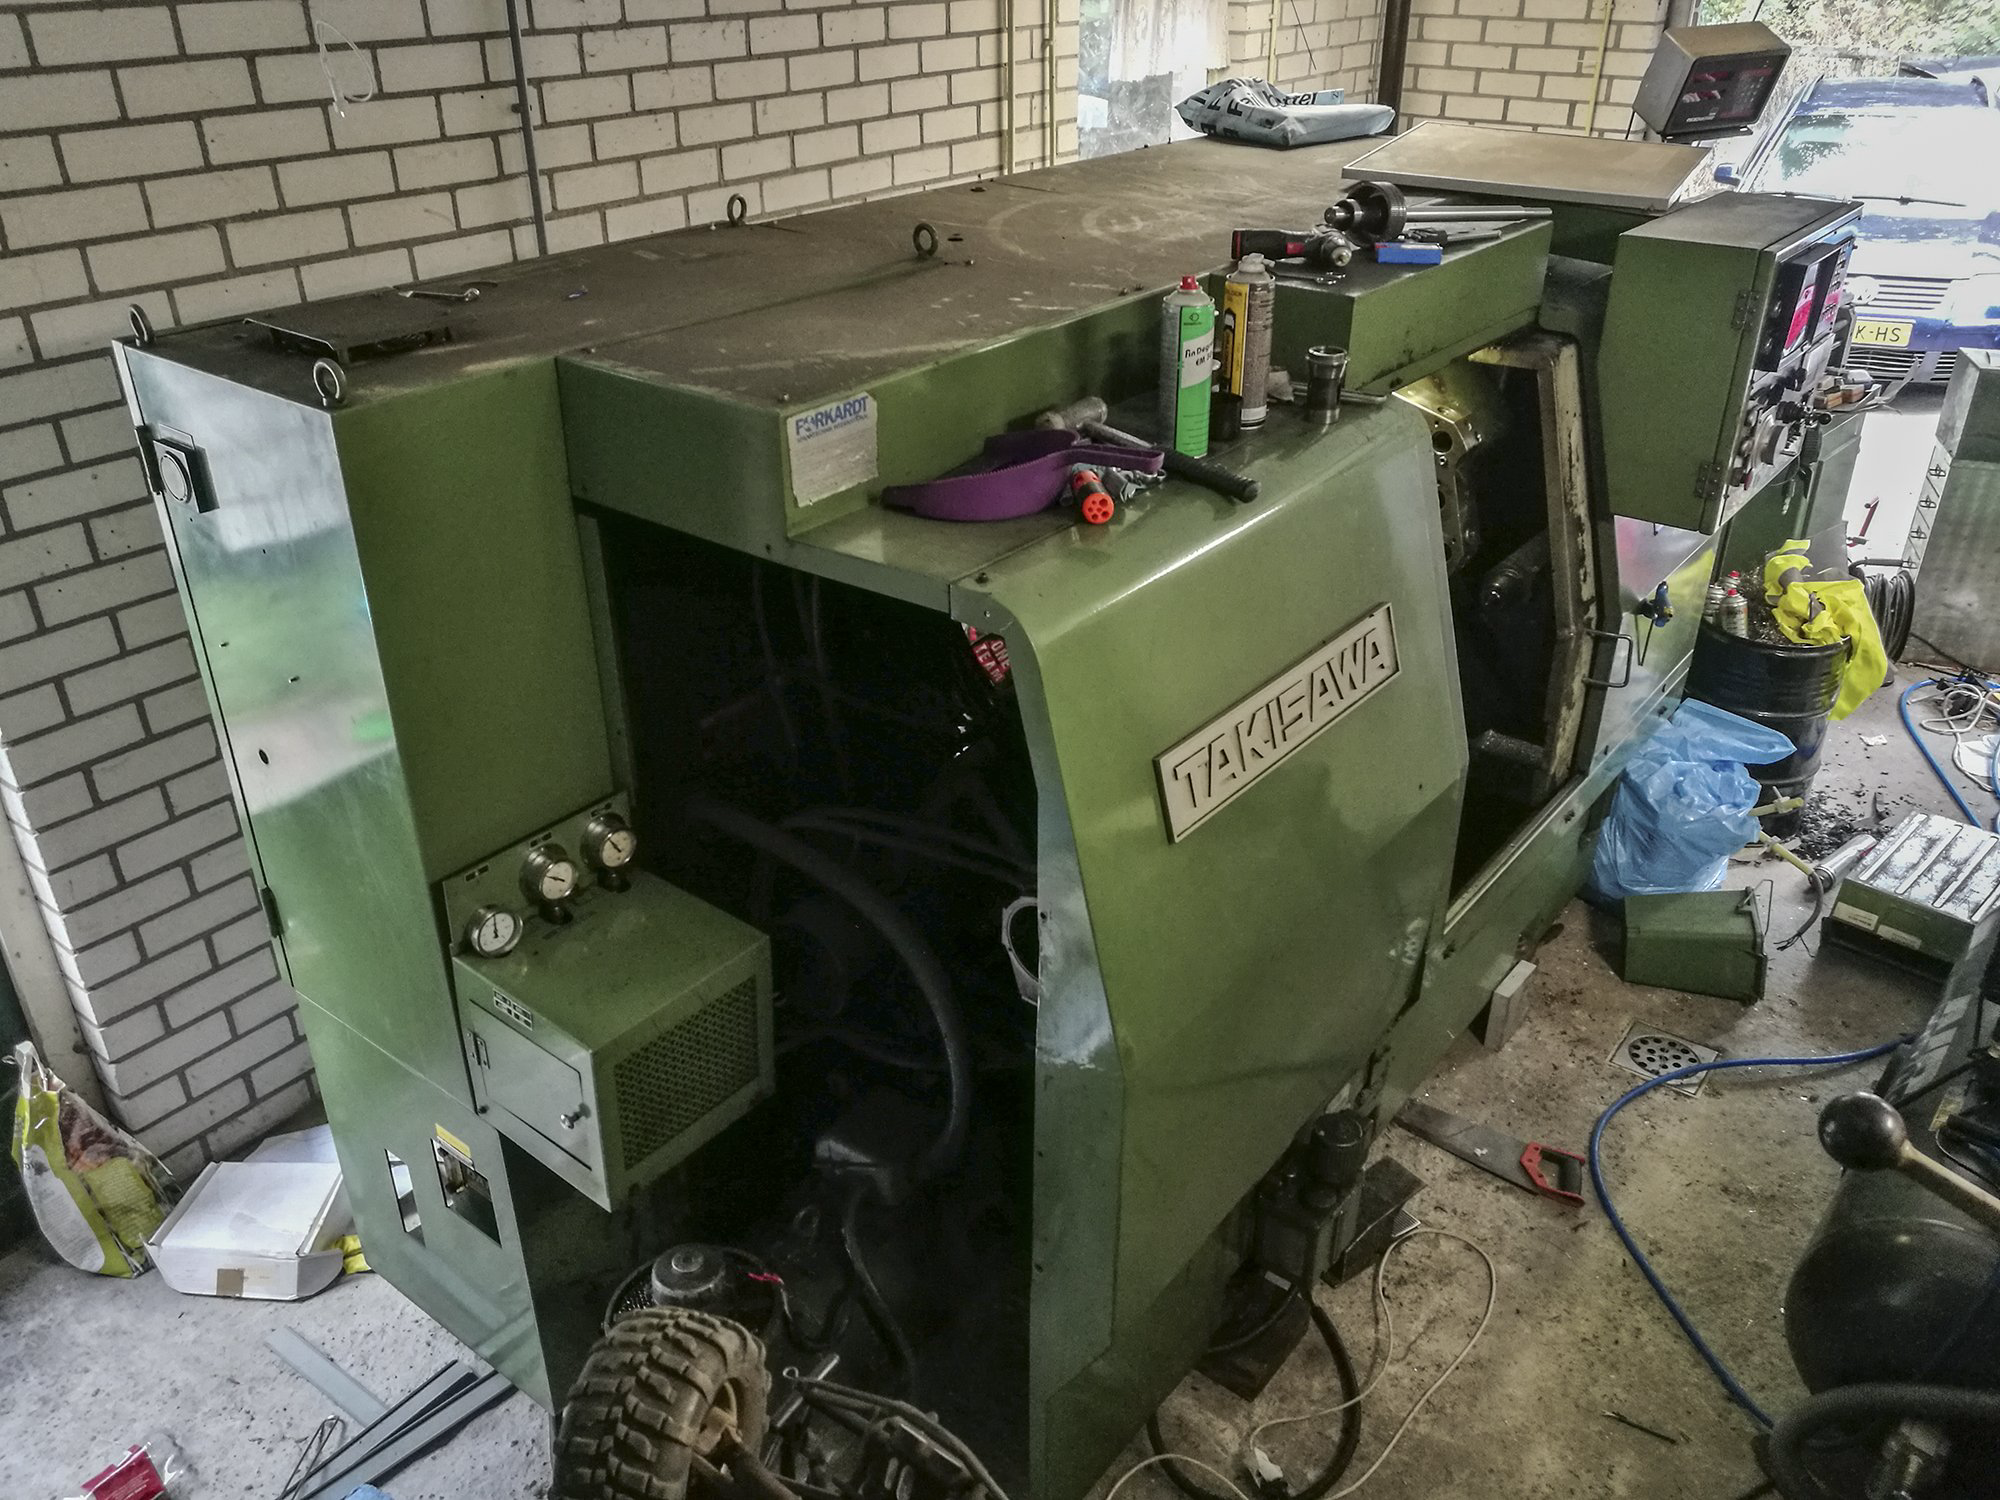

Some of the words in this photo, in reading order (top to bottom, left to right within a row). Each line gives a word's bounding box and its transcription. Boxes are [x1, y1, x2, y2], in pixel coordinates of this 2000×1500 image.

[975, 643, 1003, 682] TEAM
[991, 640, 1010, 669] ONE
[1172, 626, 1388, 810] TAKISAWA
